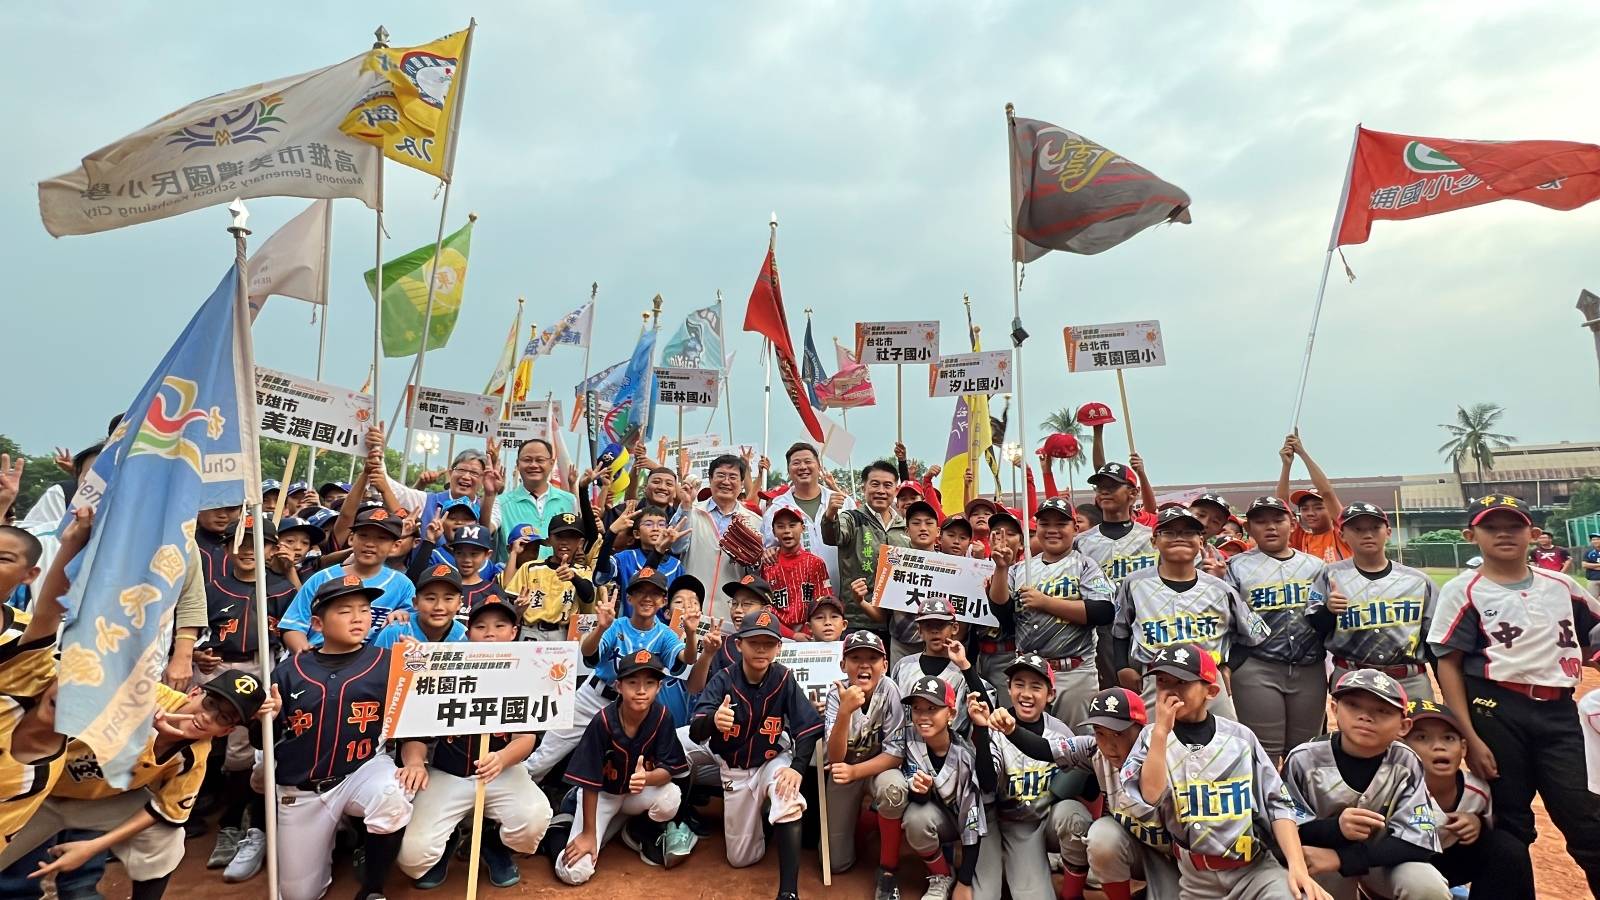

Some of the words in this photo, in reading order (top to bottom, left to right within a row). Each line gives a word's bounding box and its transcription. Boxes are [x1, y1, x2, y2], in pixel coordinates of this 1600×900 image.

[866, 337, 893, 347] 台北市
[1079, 340, 1110, 352] 台北市
[876, 346, 931, 361] 社子國小
[1092, 349, 1157, 367] 東園國小
[656, 380, 676, 390] 北市
[949, 376, 1004, 393] 汐止國小
[255, 391, 299, 413] 高雄市
[660, 390, 711, 404] 福林國小
[419, 402, 449, 415] 桃園市
[588, 393, 597, 441] EASTON
[260, 411, 358, 448] 美濃國小
[429, 414, 489, 434] 仁善國小
[1480, 494, 1518, 508] 中正
[461, 526, 480, 539] M
[1102, 555, 1155, 581] 北市
[893, 570, 934, 588] 新北市
[1338, 600, 1423, 630] 新北市
[1142, 614, 1219, 646] 新北市
[390, 676, 406, 714] BASEBALL
[416, 675, 478, 695] 桃園市
[288, 701, 380, 737] 中平
[437, 695, 558, 727] 中平國小
[346, 738, 371, 762] 10
[1174, 779, 1252, 818] 北市
